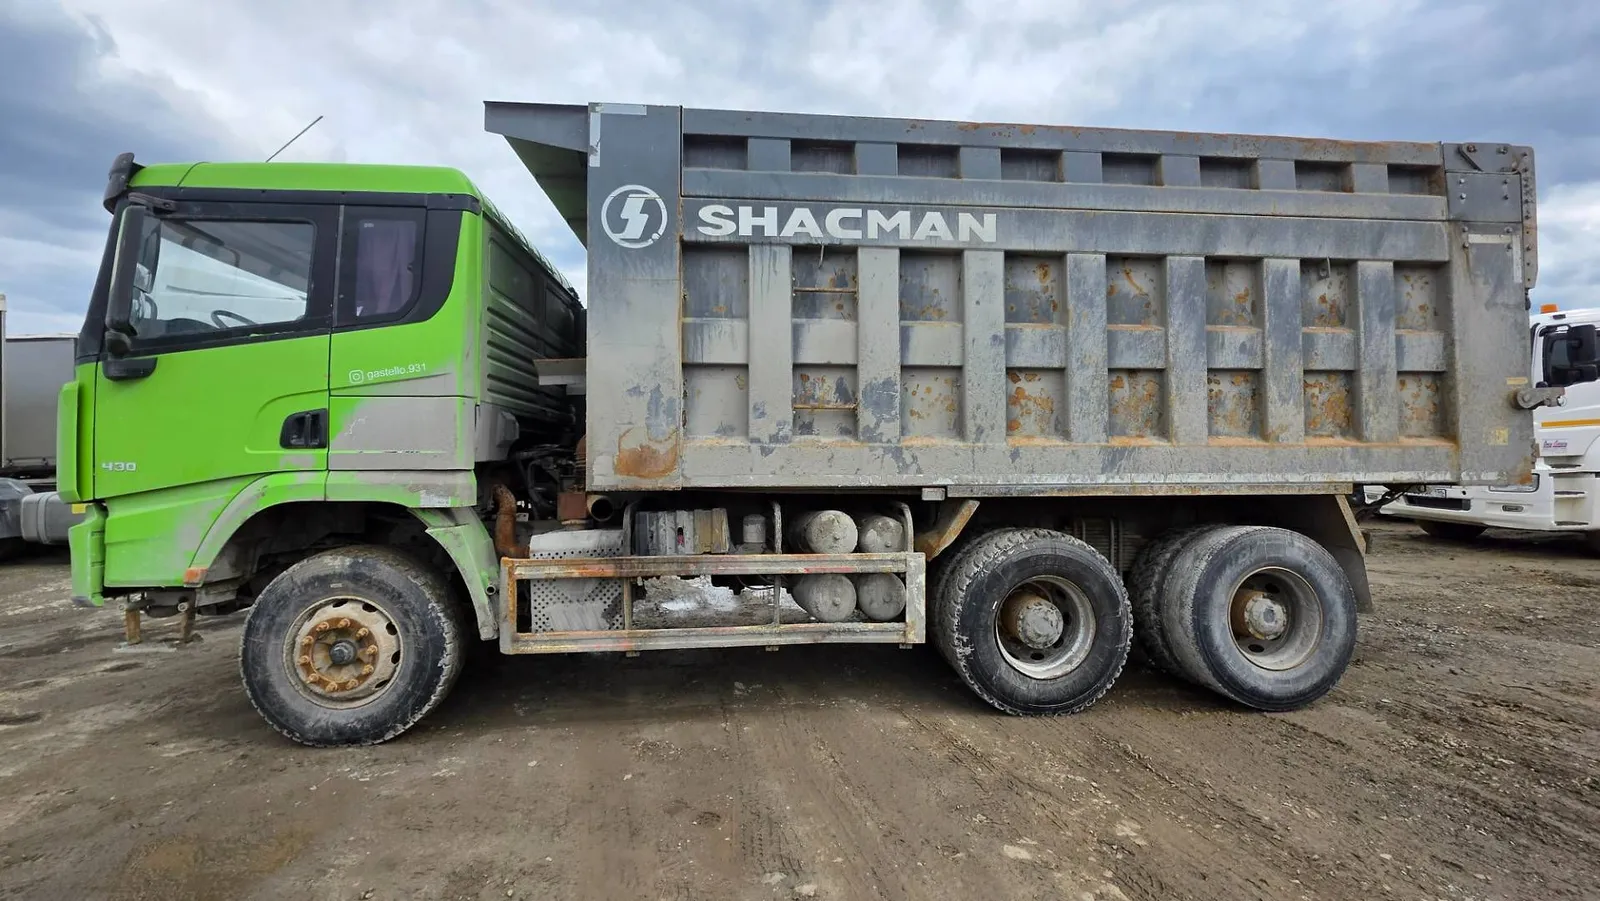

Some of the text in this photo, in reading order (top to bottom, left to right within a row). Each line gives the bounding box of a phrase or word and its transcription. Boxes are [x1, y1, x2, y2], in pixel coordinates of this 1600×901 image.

[698, 205, 996, 242] SHACMAN
[367, 362, 426, 380] gastello.931
[101, 462, 137, 471] 430
